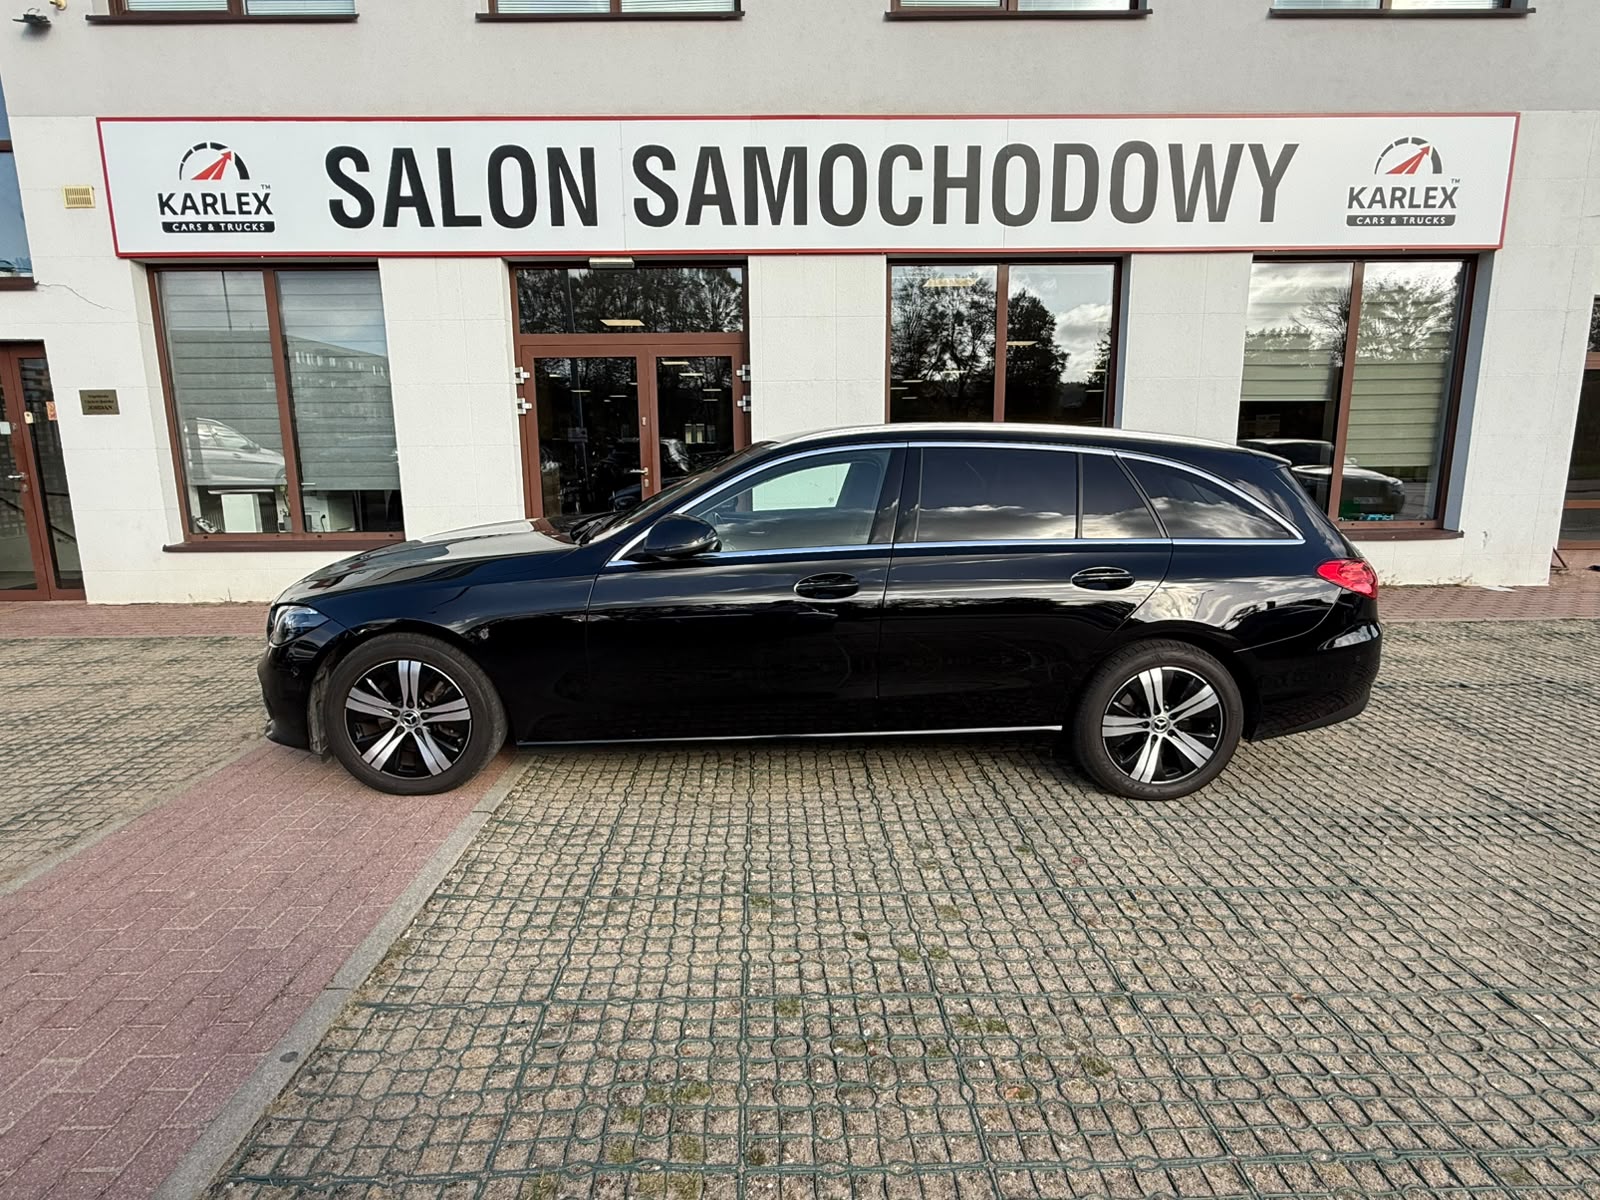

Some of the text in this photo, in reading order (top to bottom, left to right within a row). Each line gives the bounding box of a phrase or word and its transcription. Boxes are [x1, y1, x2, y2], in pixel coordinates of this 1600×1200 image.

[326, 140, 1300, 229] SALON SAMOCHODOWY
[158, 192, 273, 215] KARLEX
[1347, 187, 1459, 208] KARLEX
[172, 223, 265, 231] CARS & TRUCKS
[1356, 216, 1446, 225] CARS & TRUCKS
